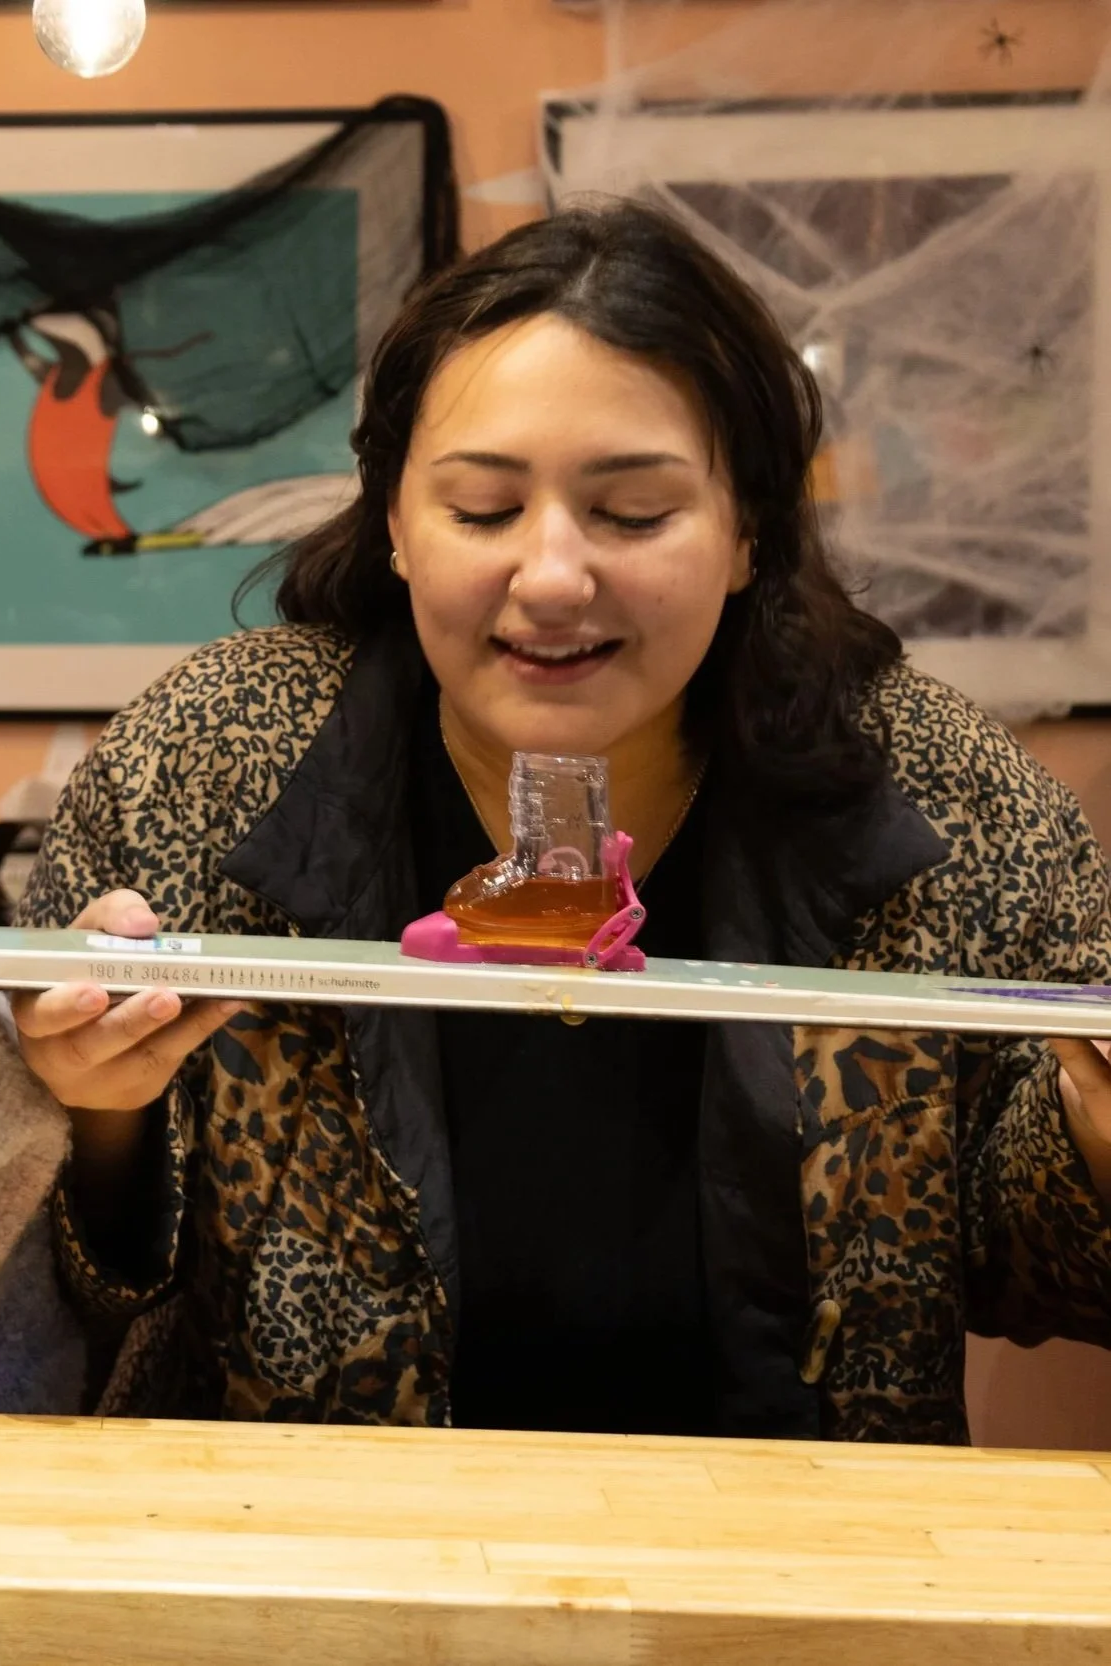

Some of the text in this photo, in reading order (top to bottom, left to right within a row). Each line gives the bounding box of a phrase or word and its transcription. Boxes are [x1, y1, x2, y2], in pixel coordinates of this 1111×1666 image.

[88, 963, 116, 978] 190
[124, 965, 134, 980] R
[141, 966, 200, 982] 304484
[317, 977, 381, 990] schuhmitte
